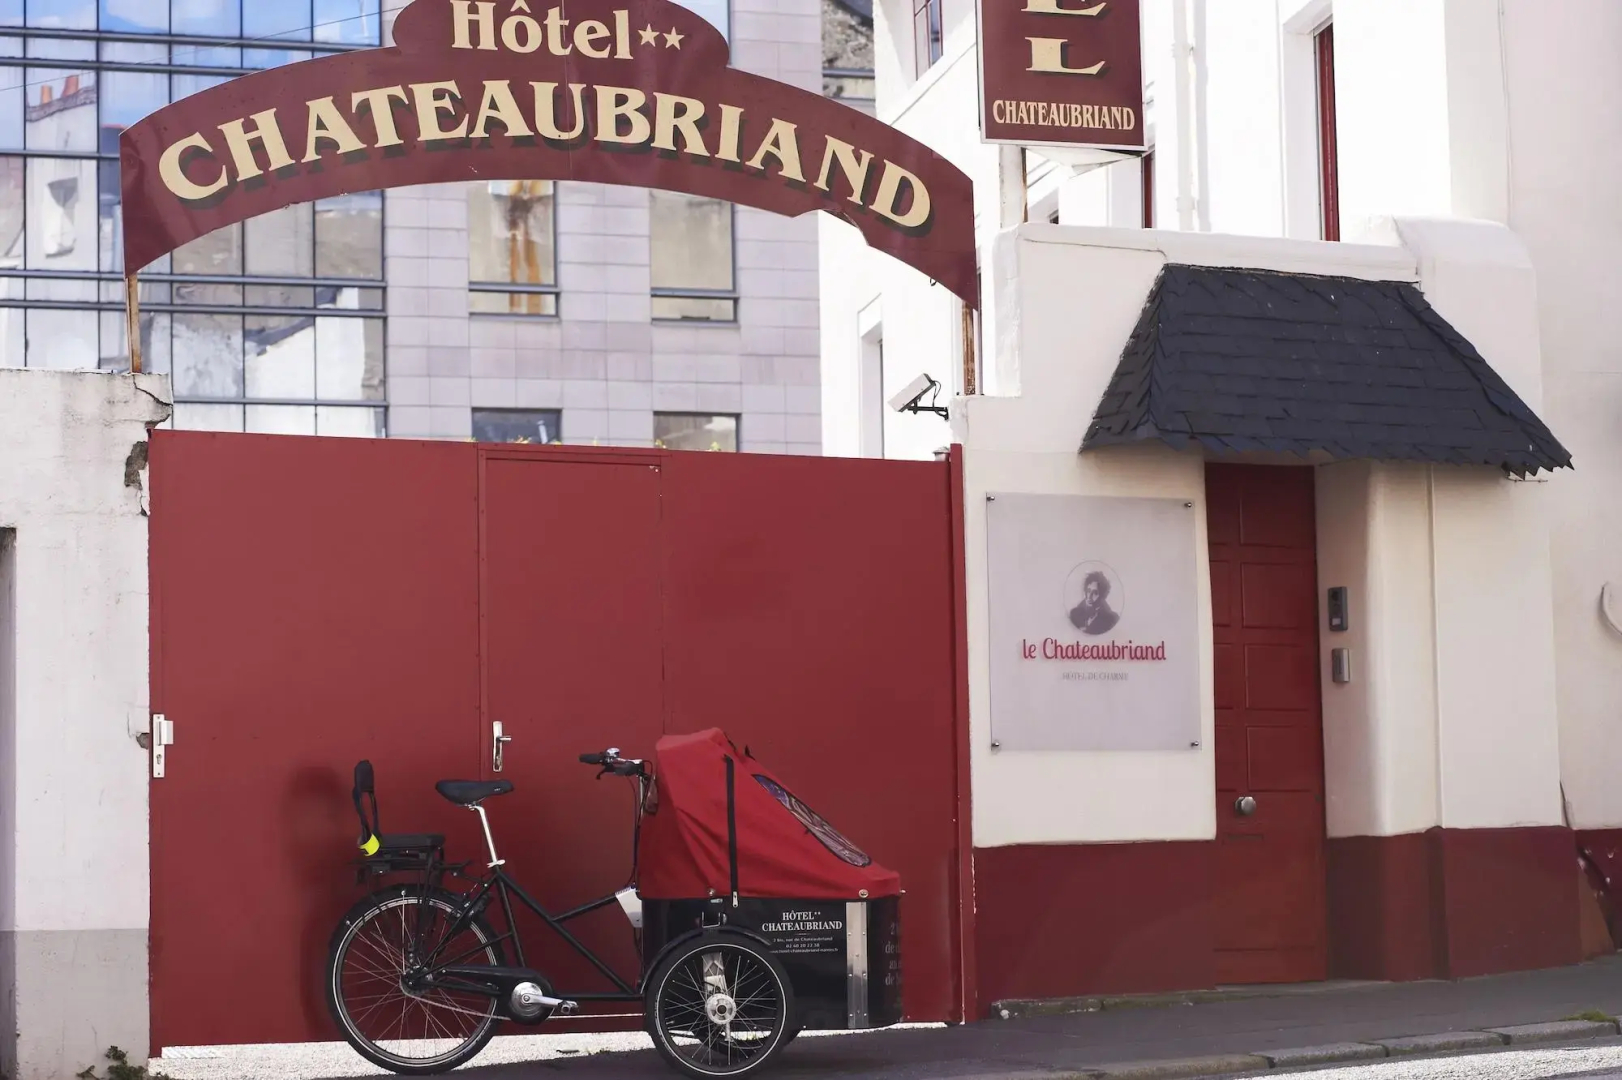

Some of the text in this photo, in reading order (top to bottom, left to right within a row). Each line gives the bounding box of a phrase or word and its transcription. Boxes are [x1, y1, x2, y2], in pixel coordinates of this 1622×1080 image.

[450, 0, 634, 60] Hôtel
[992, 99, 1136, 131] CHATEAUBRIAND
[159, 79, 931, 228] CHATEAUBRIAND
[1022, 637, 1167, 661] le Chateaubriand
[761, 920, 843, 932] CHATEAUBRIAND
